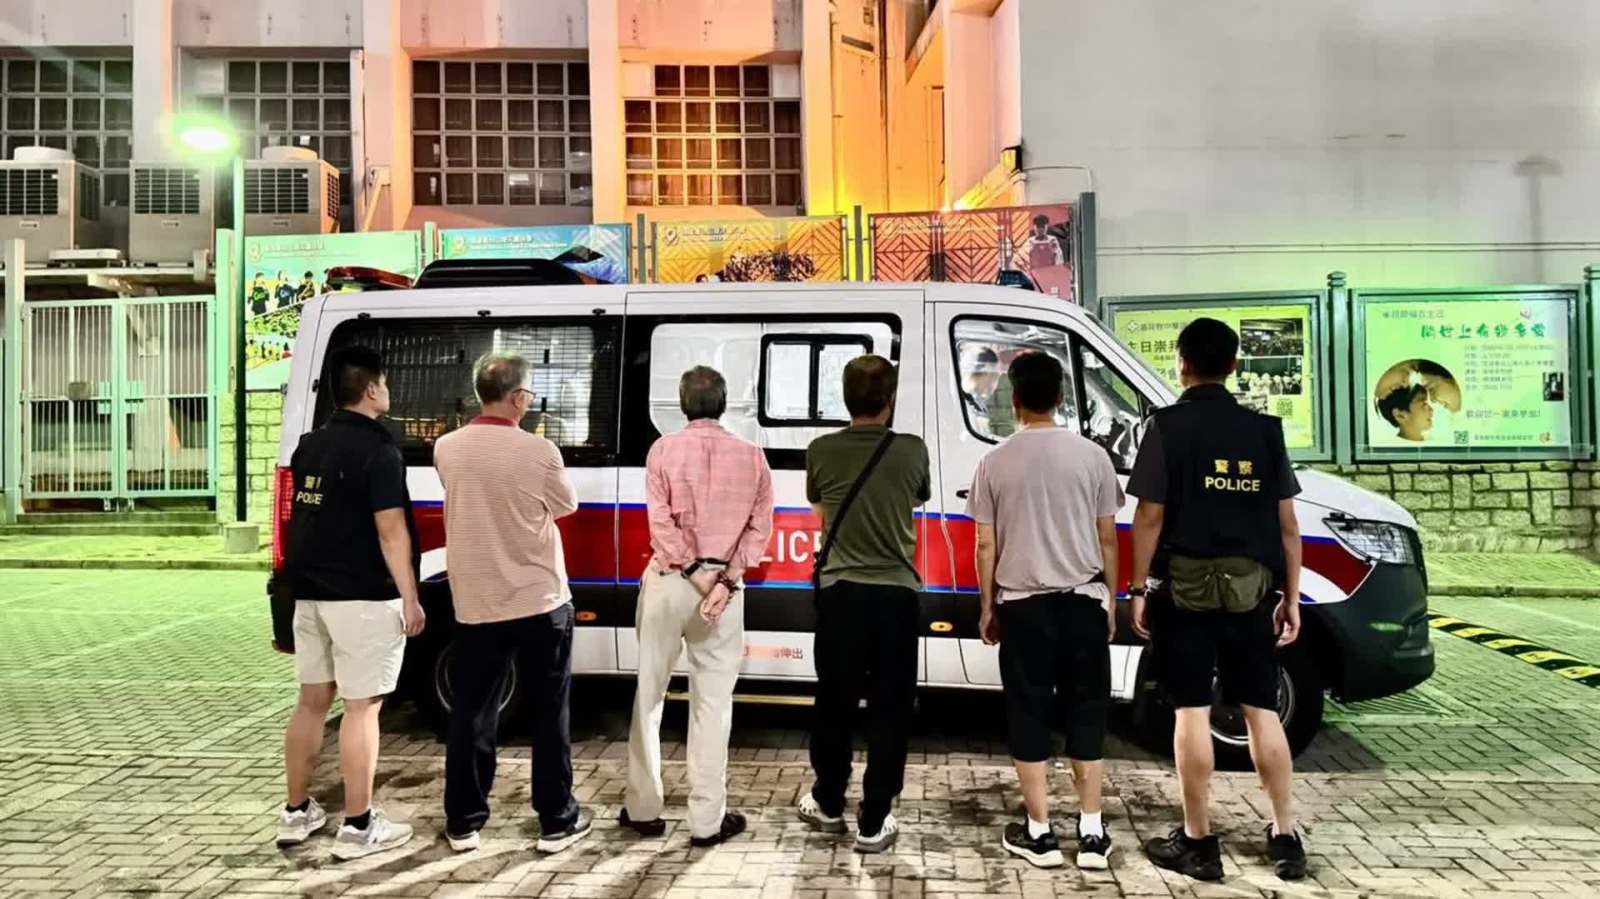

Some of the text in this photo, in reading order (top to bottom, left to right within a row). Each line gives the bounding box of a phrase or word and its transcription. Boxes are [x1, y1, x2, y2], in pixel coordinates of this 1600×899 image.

[1214, 459, 1253, 475] 警察
[304, 475, 322, 489] 警
[1204, 476, 1261, 492] POLICE
[295, 490, 324, 505] POE
